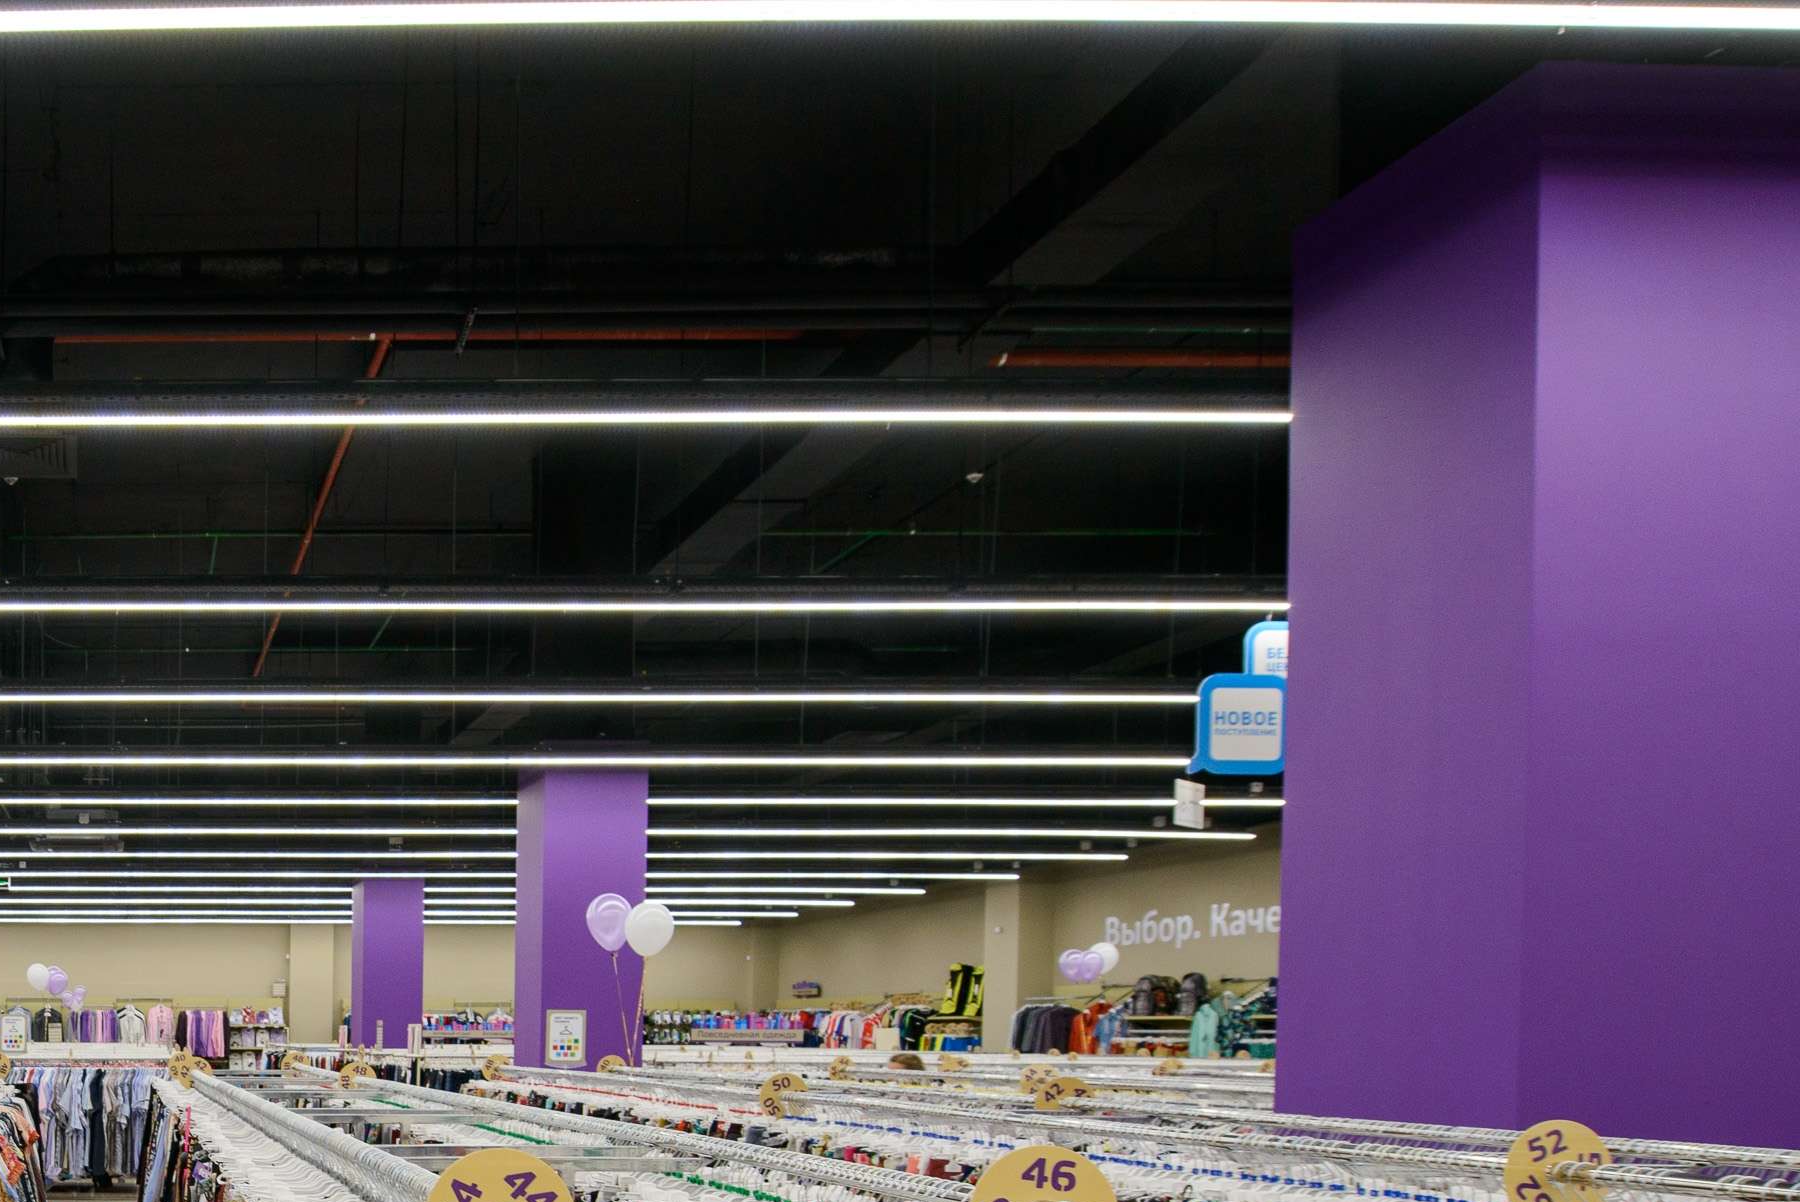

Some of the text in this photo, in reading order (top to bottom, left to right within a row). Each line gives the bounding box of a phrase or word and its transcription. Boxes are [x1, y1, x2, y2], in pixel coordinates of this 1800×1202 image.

[1267, 648, 1288, 660] БЕ
[1214, 711, 1278, 726] НОВОЕ
[1104, 909, 1201, 949] Выбор.
[352, 1065, 367, 1076] 48
[772, 1077, 791, 1091] 50
[1044, 1082, 1065, 1103] 42
[763, 1097, 781, 1116] 50
[1528, 1129, 1569, 1162] 52
[1021, 1157, 1077, 1192] 46
